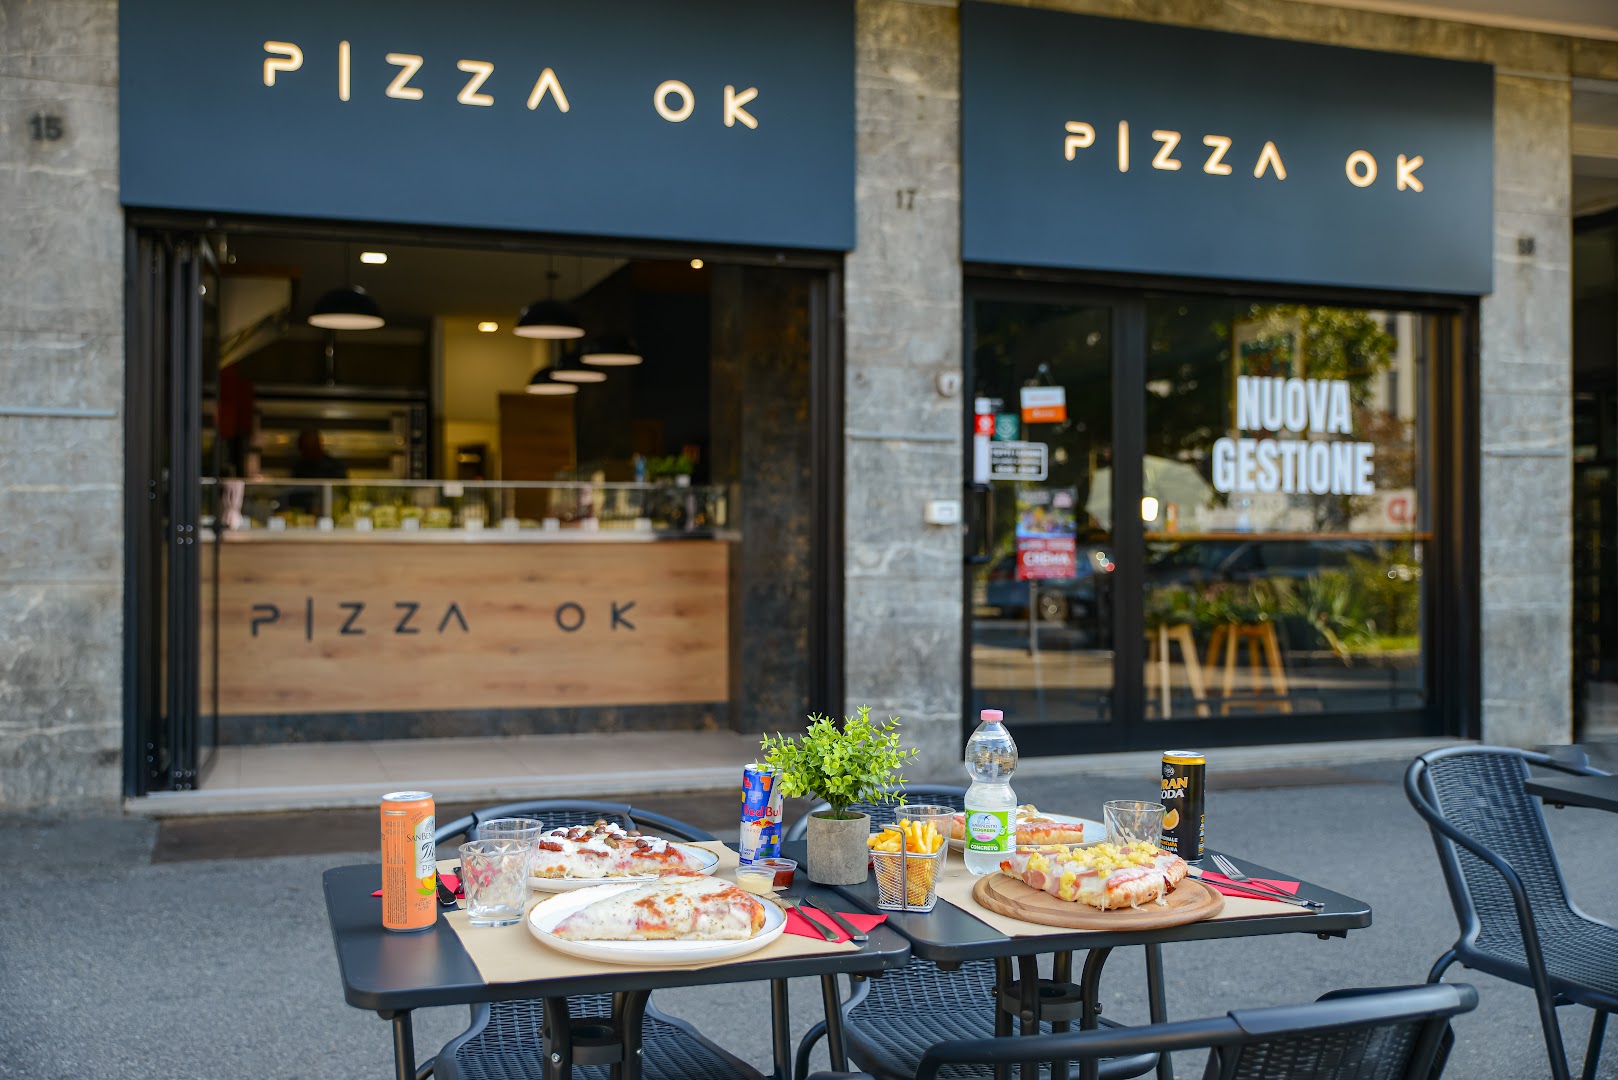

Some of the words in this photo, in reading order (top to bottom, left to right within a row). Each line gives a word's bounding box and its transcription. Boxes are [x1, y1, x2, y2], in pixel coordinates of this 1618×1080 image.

[263, 40, 570, 113] PIZZA
[653, 79, 760, 130] OK
[29, 113, 65, 141] 15
[1064, 120, 1287, 181] PIZZA
[1345, 149, 1425, 193] OK
[895, 188, 917, 211] 17
[1237, 376, 1353, 434] NUOVA
[1212, 437, 1376, 496] GESTIONE
[251, 597, 469, 641] PIZZA
[554, 601, 637, 633] OK
[1161, 777, 1188, 789] RAN
[1161, 789, 1184, 799] ODA
[744, 804, 764, 817] Red
